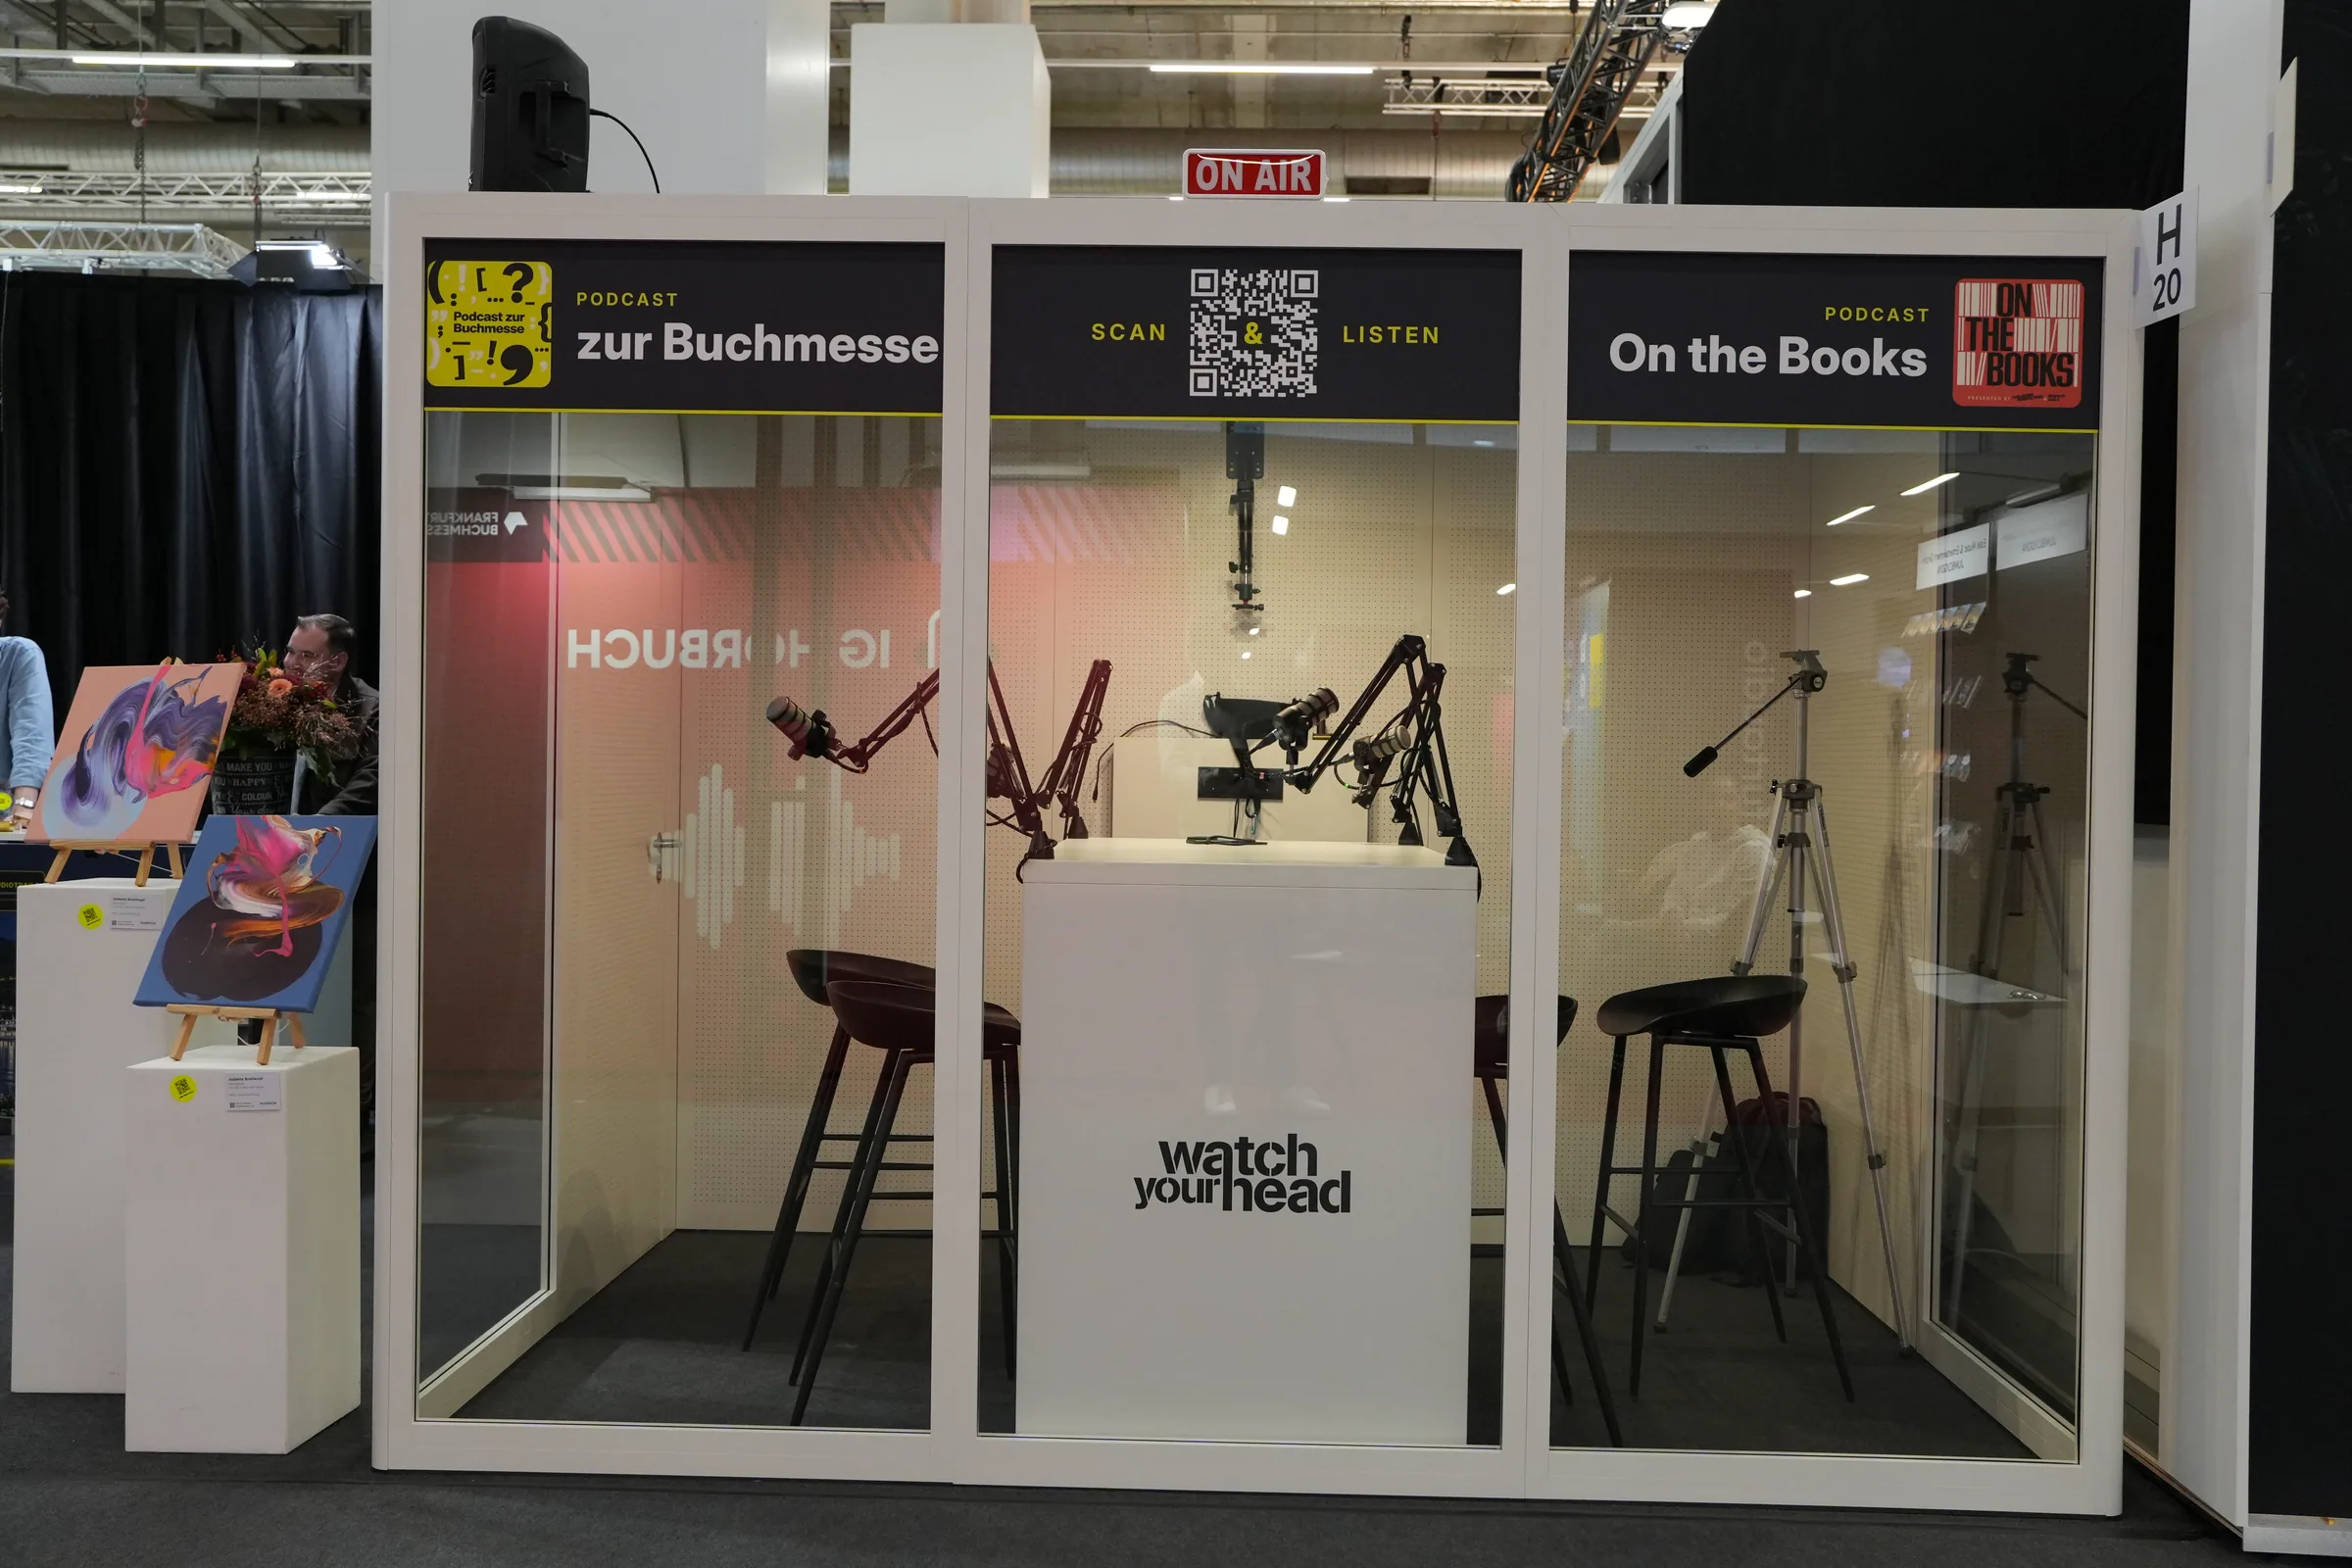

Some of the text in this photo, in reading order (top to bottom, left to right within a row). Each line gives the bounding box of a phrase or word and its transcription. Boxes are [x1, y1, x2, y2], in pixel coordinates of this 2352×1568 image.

[1196, 158, 1312, 191] ON AIR
[2156, 203, 2182, 266] H
[576, 291, 678, 307] PODCAST
[1996, 282, 2033, 318] ON
[2152, 268, 2181, 312] 20
[454, 312, 525, 322] Podcast zur
[454, 323, 525, 334] Buchmesse
[1825, 306, 1930, 322] PODCAST
[577, 321, 939, 364] zur Buchmesse
[1091, 321, 1440, 345] SCAN & LISTEN
[1965, 317, 2014, 352] THE
[1609, 332, 1928, 377] On the Books
[1986, 352, 2074, 388] BOOKS
[226, 762, 253, 772] MAKE
[1158, 1133, 1318, 1177] watch
[1133, 1170, 1351, 1214] your head
